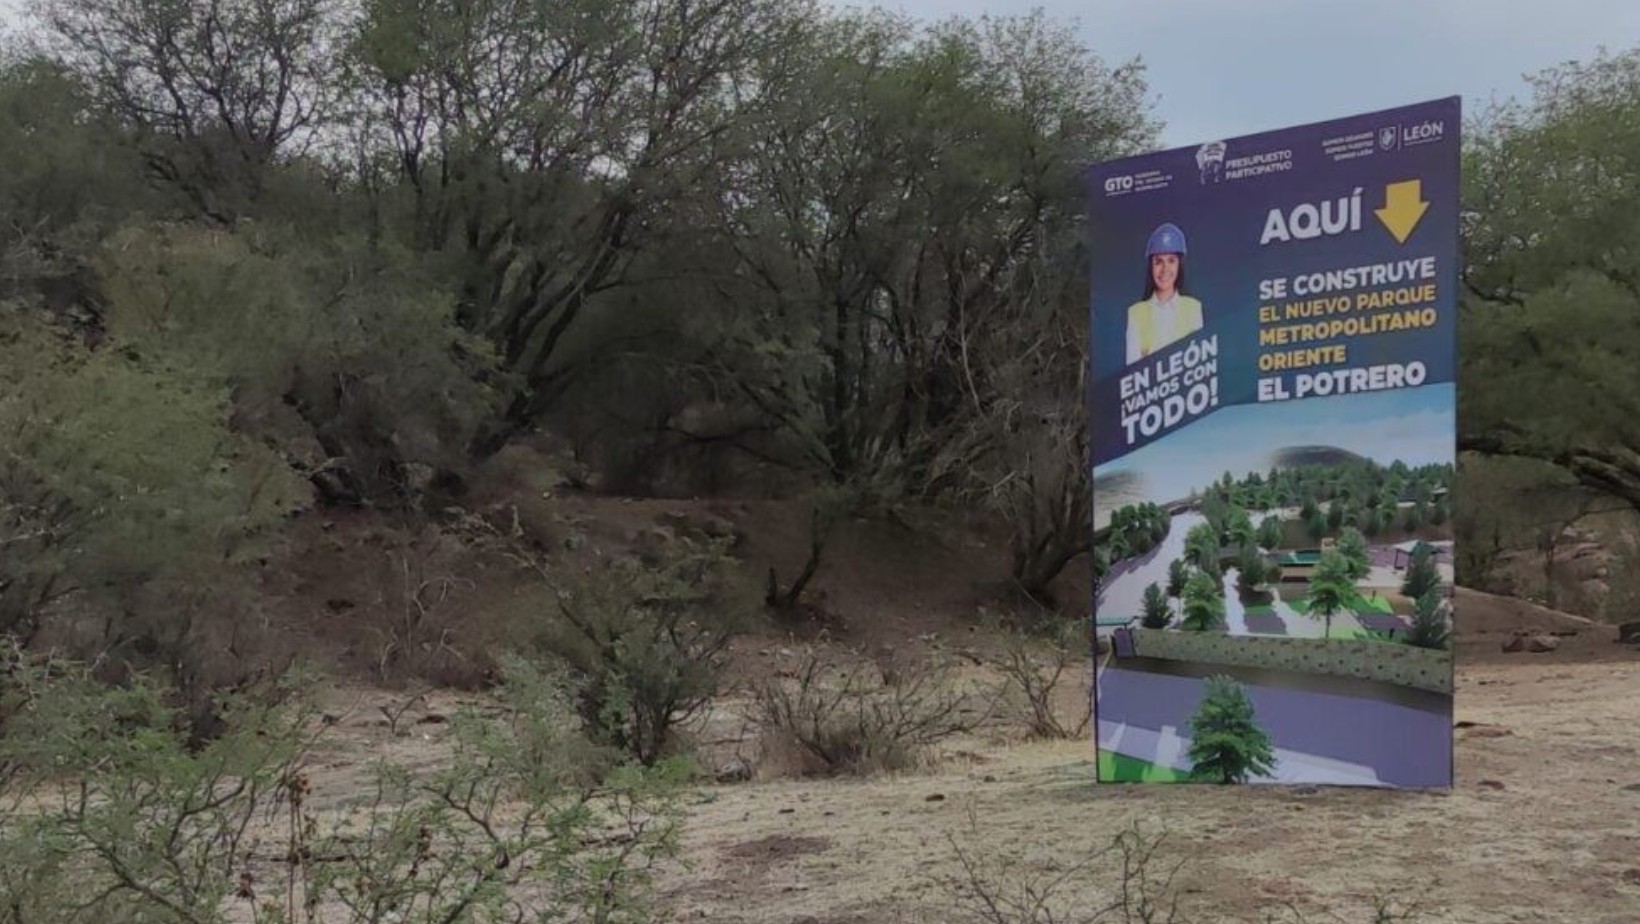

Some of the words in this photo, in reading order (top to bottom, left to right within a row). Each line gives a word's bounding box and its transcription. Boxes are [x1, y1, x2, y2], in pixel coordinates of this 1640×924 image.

[1404, 120, 1443, 141] LEÓN
[1226, 149, 1292, 169] PRESUPUESTO
[1226, 161, 1292, 179] PARTICIPATIVO
[1105, 175, 1133, 191] GTO
[1260, 187, 1364, 245] AQUÍ
[1260, 278, 1287, 300] SE
[1293, 256, 1436, 296] CONSTRUYE
[1259, 306, 1281, 323] EL
[1286, 296, 1351, 319] NUEVO
[1357, 285, 1436, 311] PARQUE
[1259, 308, 1437, 346] METROPOLITANO
[1120, 367, 1149, 399] EN
[1156, 334, 1218, 382] LEÓN
[1183, 359, 1217, 386] CON
[1259, 345, 1346, 371] ORIENTE
[1258, 376, 1289, 402] EL
[1296, 361, 1426, 398] POTRERO
[1121, 376, 1218, 444] TODO!
